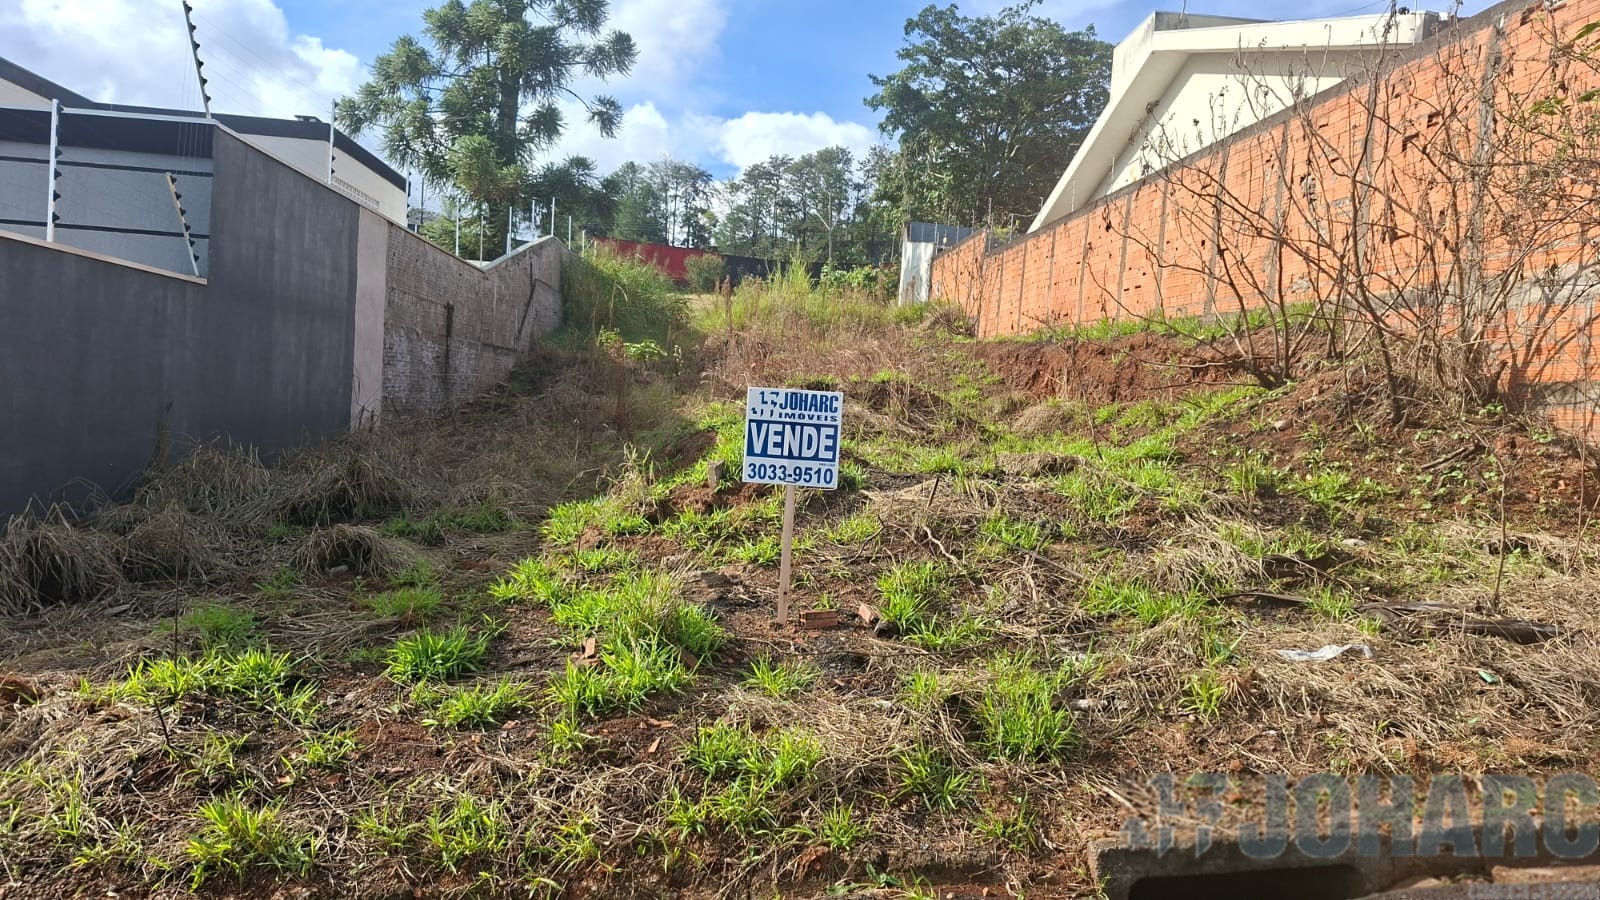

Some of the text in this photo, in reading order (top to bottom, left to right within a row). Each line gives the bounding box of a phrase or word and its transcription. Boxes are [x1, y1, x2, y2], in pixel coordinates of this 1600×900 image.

[779, 391, 839, 413] JOHARC
[750, 422, 835, 459] VENDE
[747, 462, 833, 485] 3033-9510
